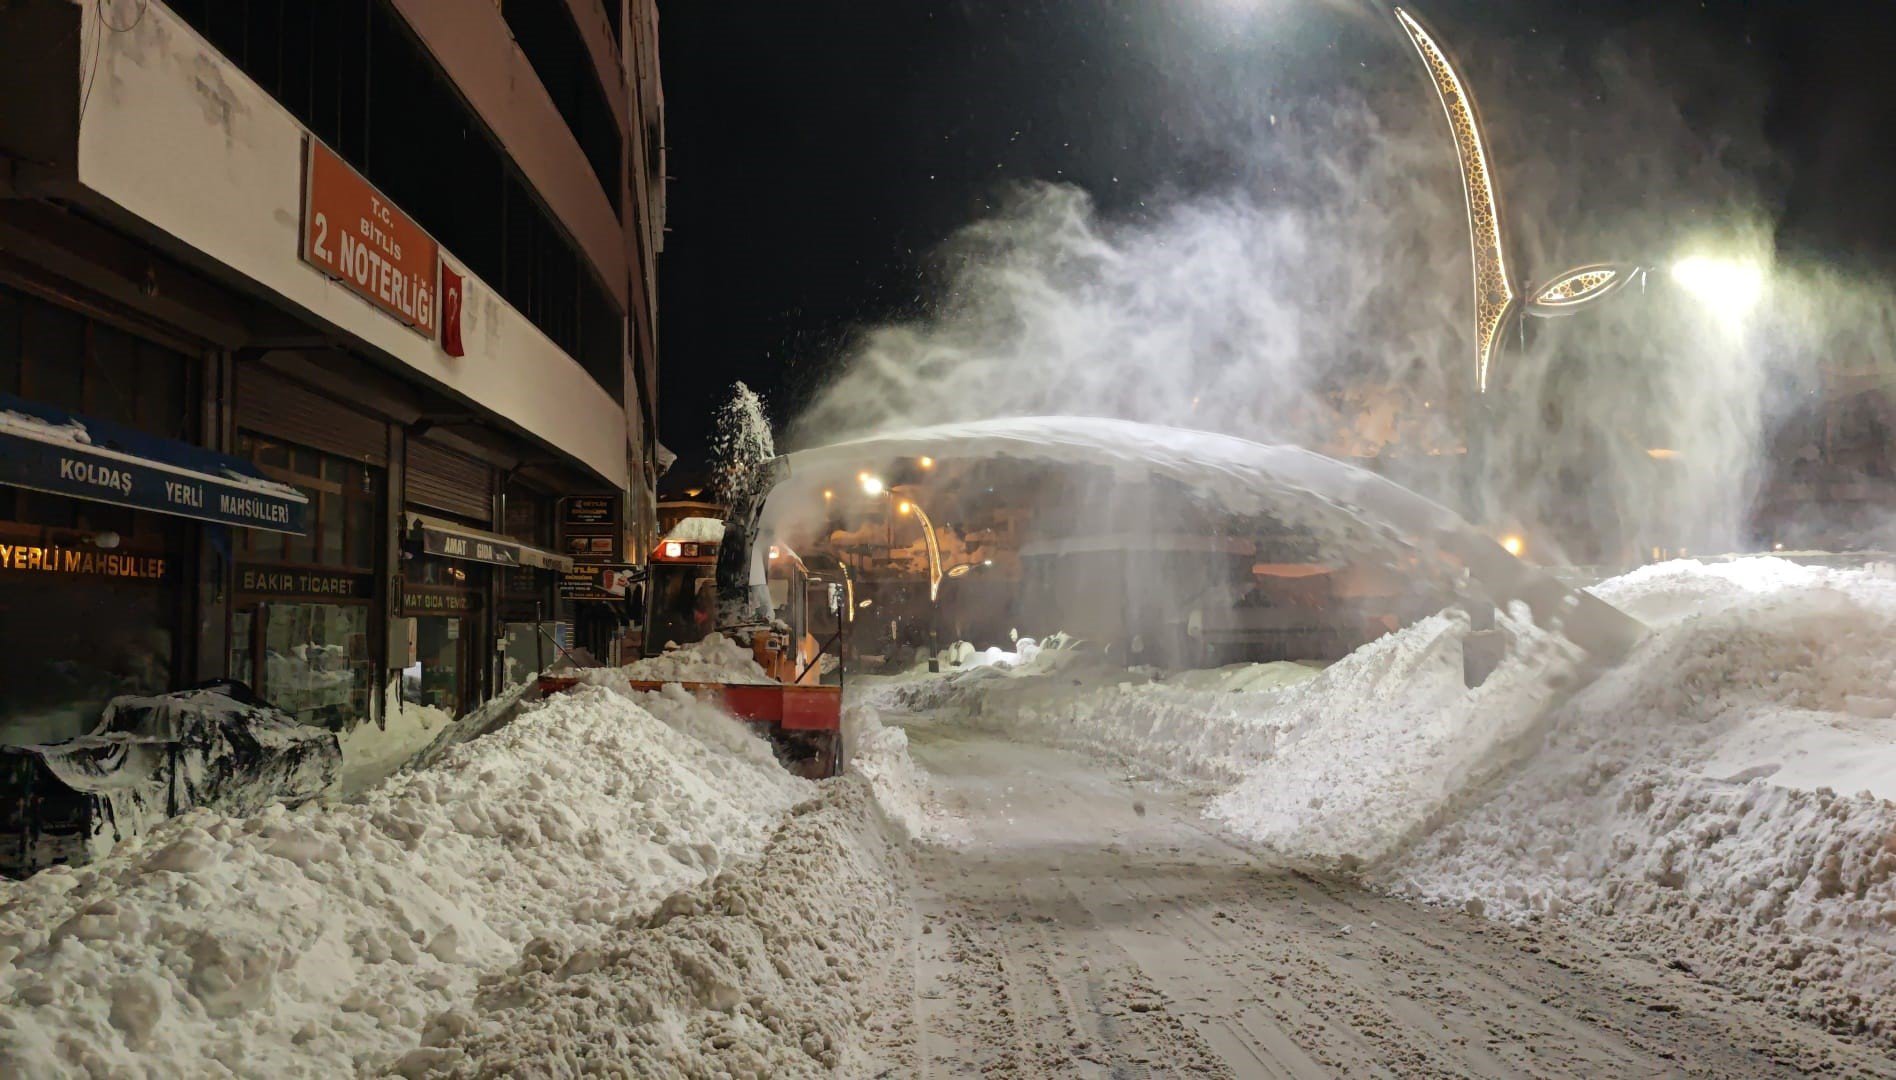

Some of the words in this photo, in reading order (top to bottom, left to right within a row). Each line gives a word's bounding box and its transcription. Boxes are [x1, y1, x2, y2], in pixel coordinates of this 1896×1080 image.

[371, 197, 394, 228] T.C.
[360, 217, 401, 261] BİTLİS
[313, 212, 333, 264] 2.
[340, 229, 434, 330] NOTERLİĞİ
[60, 458, 132, 496] KOLDAŞ
[165, 480, 203, 508] YERLİ
[220, 494, 289, 523] MAHSÜLLERİ
[0, 543, 59, 571] YERLİ
[299, 571, 354, 594] TİCARET
